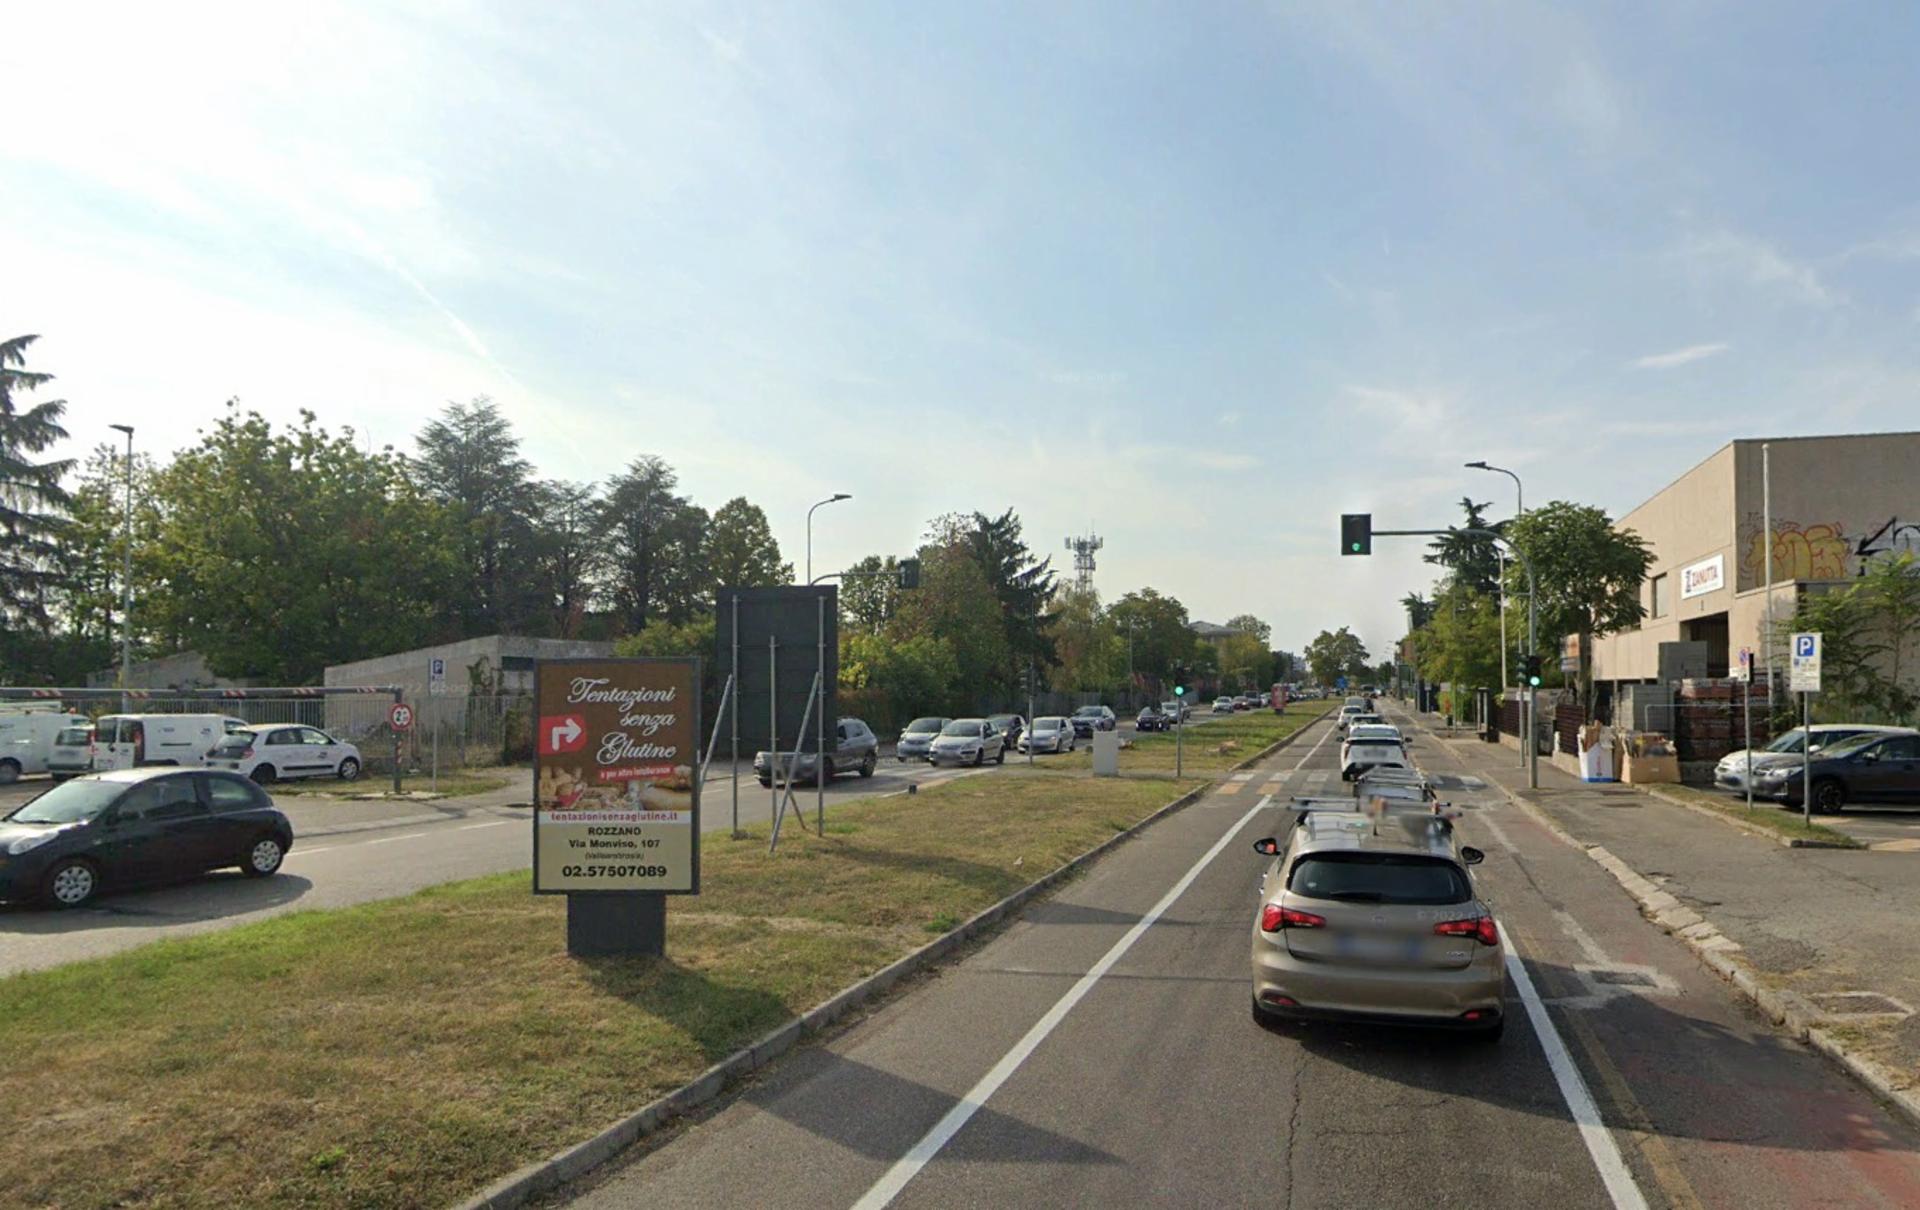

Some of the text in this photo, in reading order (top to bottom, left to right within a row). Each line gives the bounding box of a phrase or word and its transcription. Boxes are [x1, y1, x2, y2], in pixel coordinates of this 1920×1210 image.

[1800, 638, 1811, 656] P
[567, 677, 676, 712] Tentazioni
[620, 711, 677, 736] senza
[596, 732, 677, 765] Glutine
[551, 811, 678, 822] tentazionisenzaglutine.it
[588, 826, 642, 836] ROZZANO
[569, 839, 660, 850] Via Monviso, 107
[562, 865, 667, 877] 02.57507089
